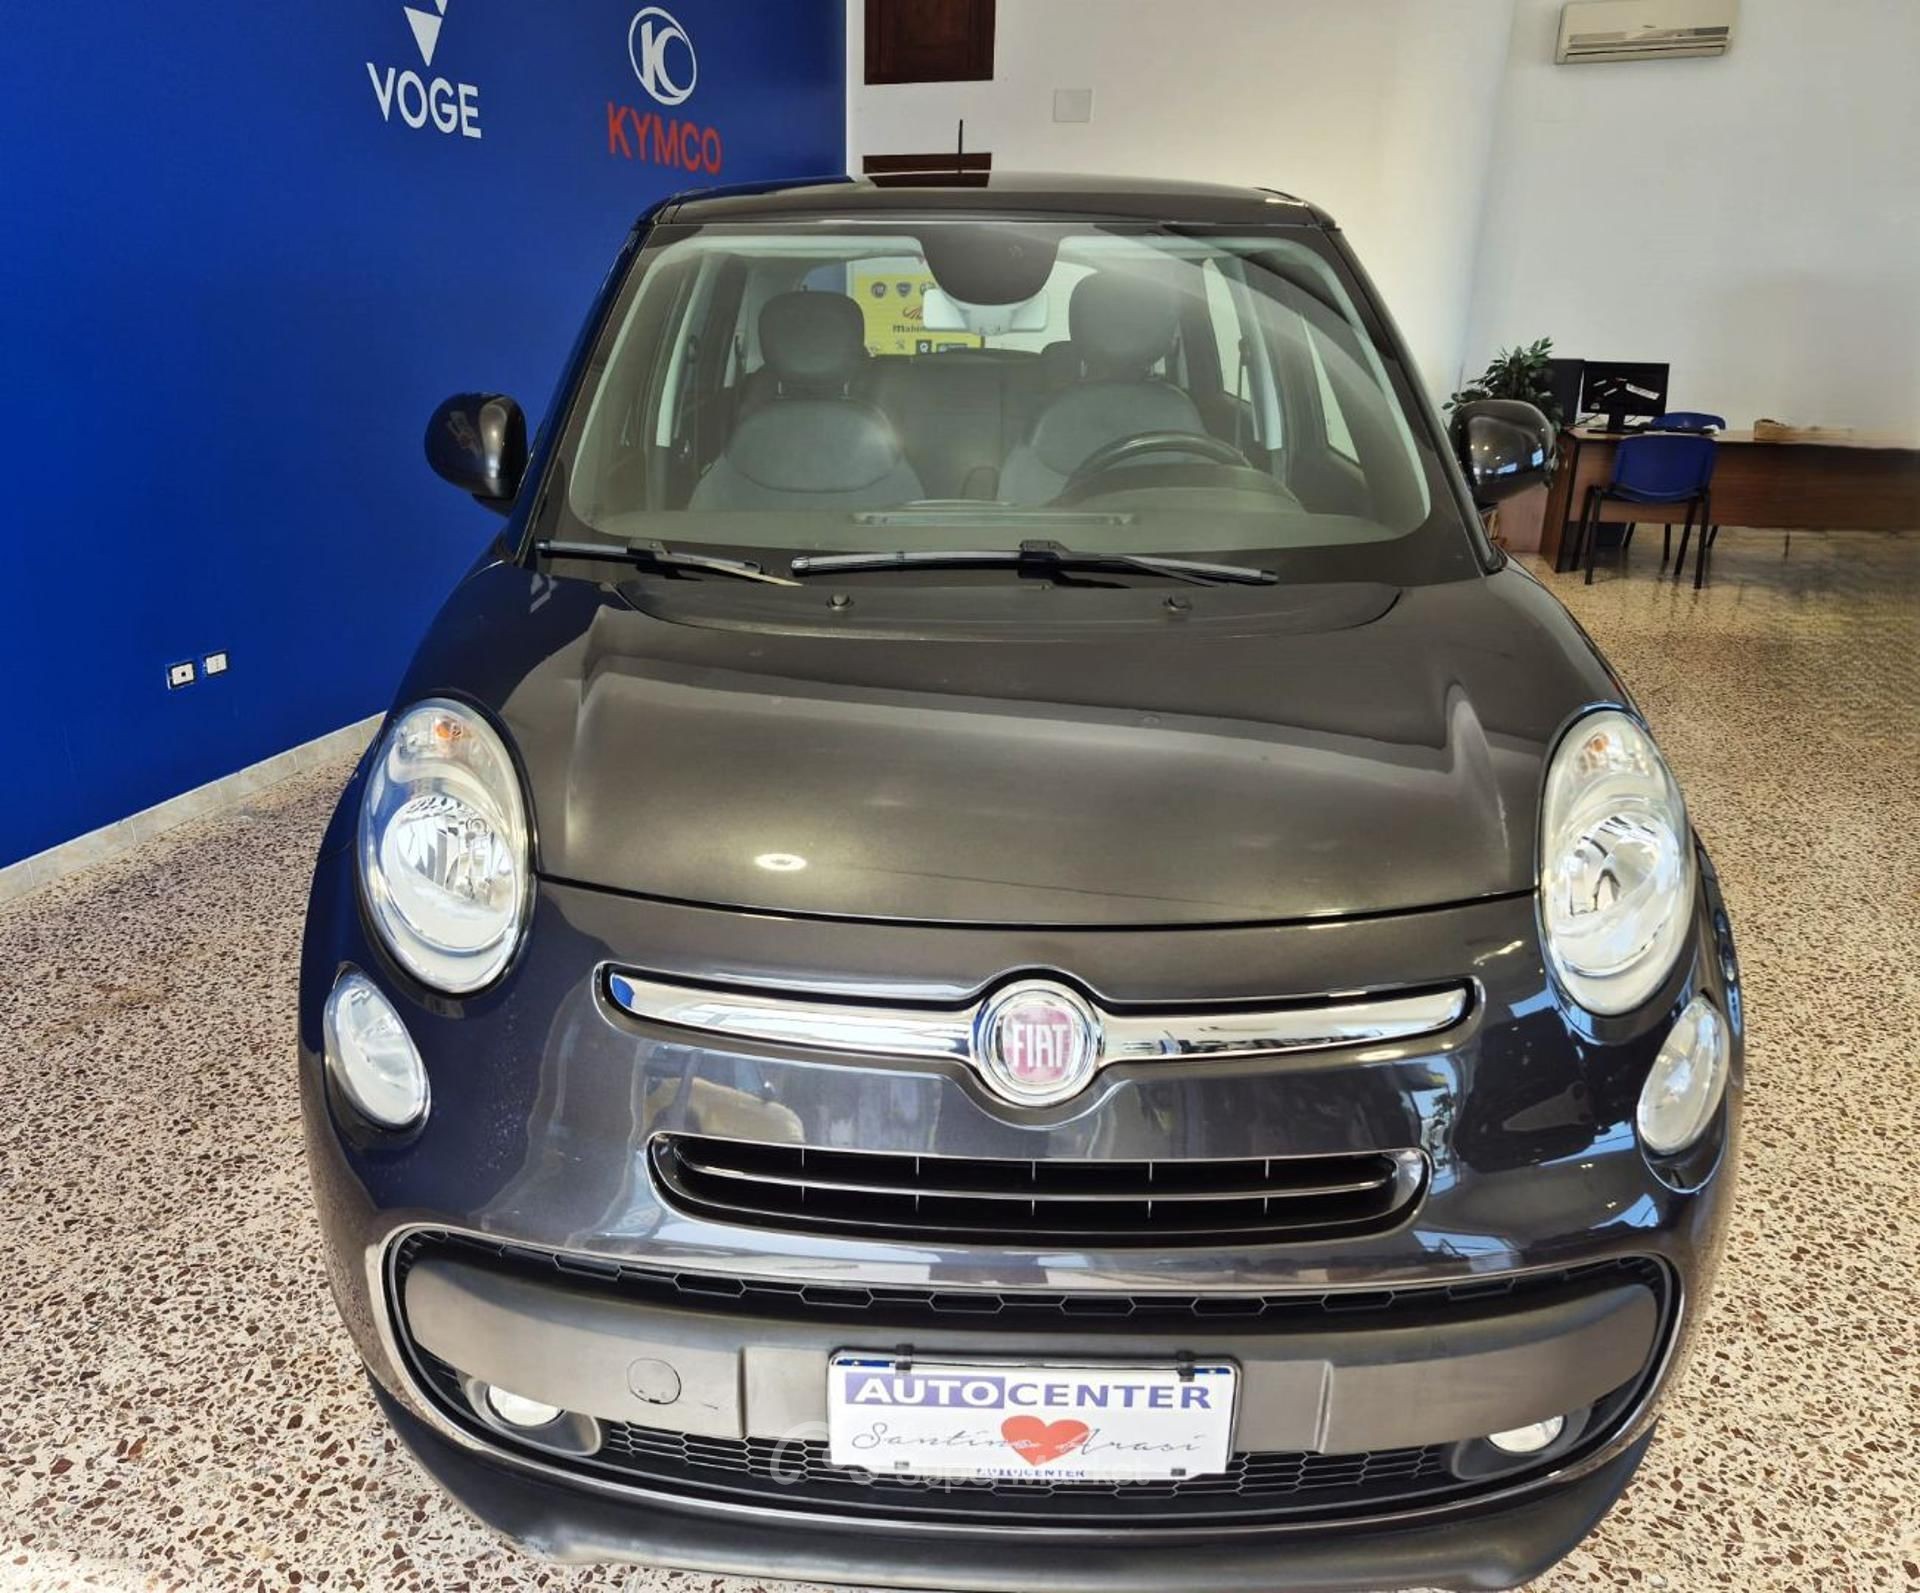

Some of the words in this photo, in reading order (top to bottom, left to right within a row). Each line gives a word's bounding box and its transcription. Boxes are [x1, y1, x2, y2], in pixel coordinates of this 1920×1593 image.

[366, 62, 482, 139] VOGE
[607, 101, 723, 174] KYMCO
[1011, 1023, 1069, 1068] FIAT
